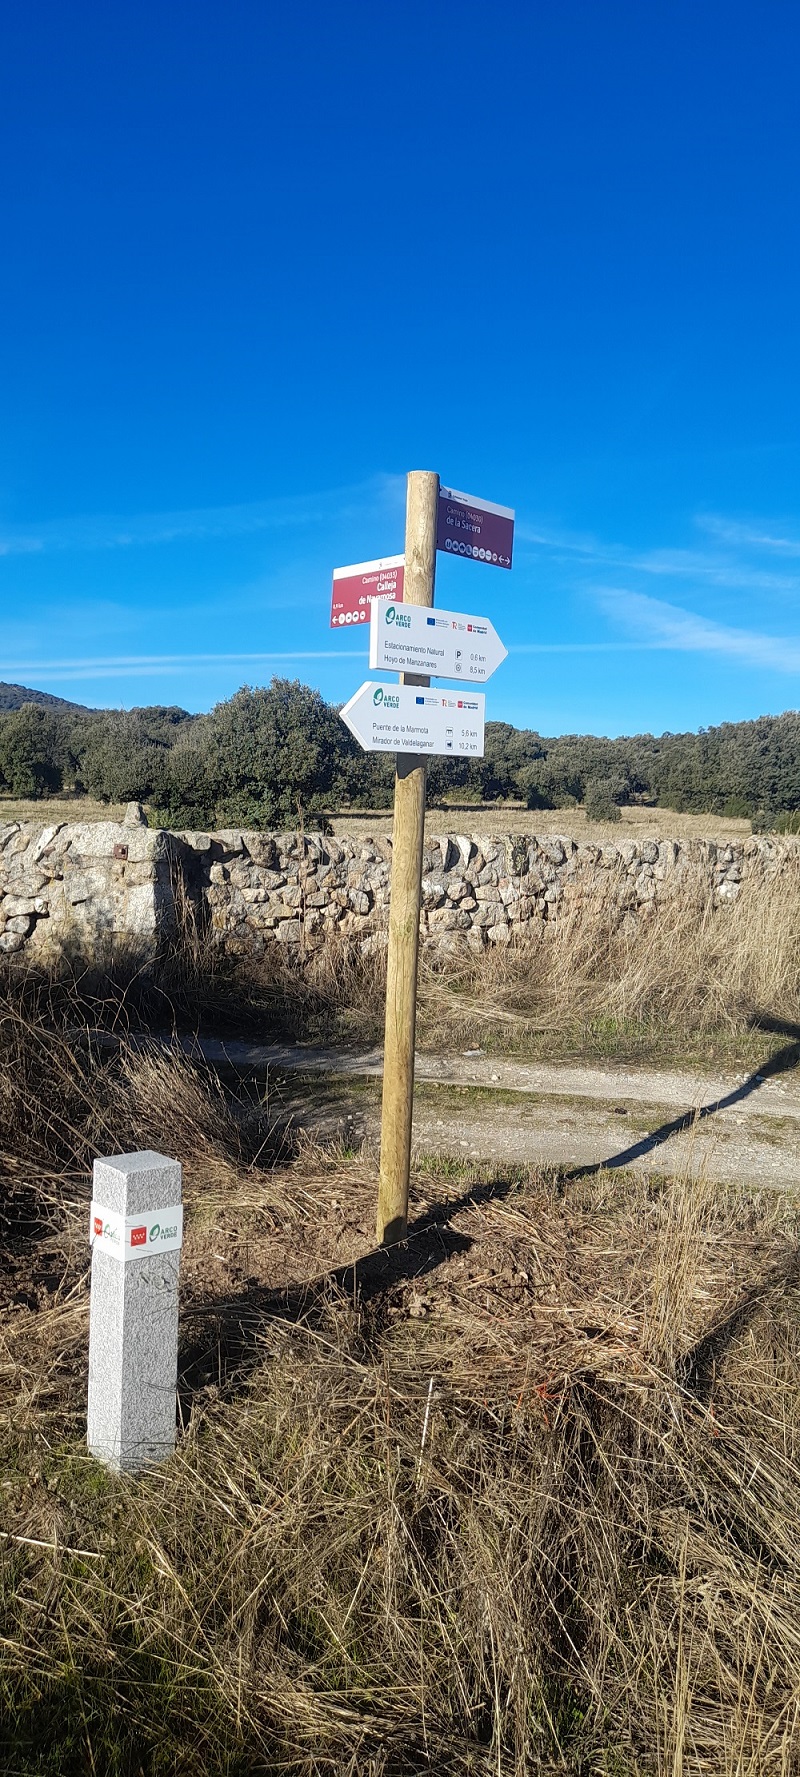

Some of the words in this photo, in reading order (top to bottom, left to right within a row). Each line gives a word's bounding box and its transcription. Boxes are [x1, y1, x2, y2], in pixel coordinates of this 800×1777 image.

[447, 506, 465, 518] Camino
[447, 516, 453, 525] de
[455, 517, 460, 527] la
[462, 520, 481, 534] Sacera
[362, 576, 379, 584] Camino
[377, 581, 396, 591] Calleja
[359, 596, 366, 605] de
[395, 614, 411, 622] ARCO
[384, 641, 426, 654] Estacionamiento
[427, 647, 445, 657] Natural
[384, 655, 398, 665] Hoyo
[407, 657, 437, 669] Manzanares
[479, 654, 486, 662] km
[478, 667, 485, 675] km
[372, 722, 391, 732] Puente
[392, 724, 399, 732] de
[400, 724, 406, 732] la
[406, 725, 429, 734] Marmota
[372, 736, 392, 745] Mirador
[393, 738, 400, 746] de
[402, 738, 434, 749] Valdelaganar
[160, 1225, 178, 1235] ARCO
[160, 1231, 177, 1240] VERDE
